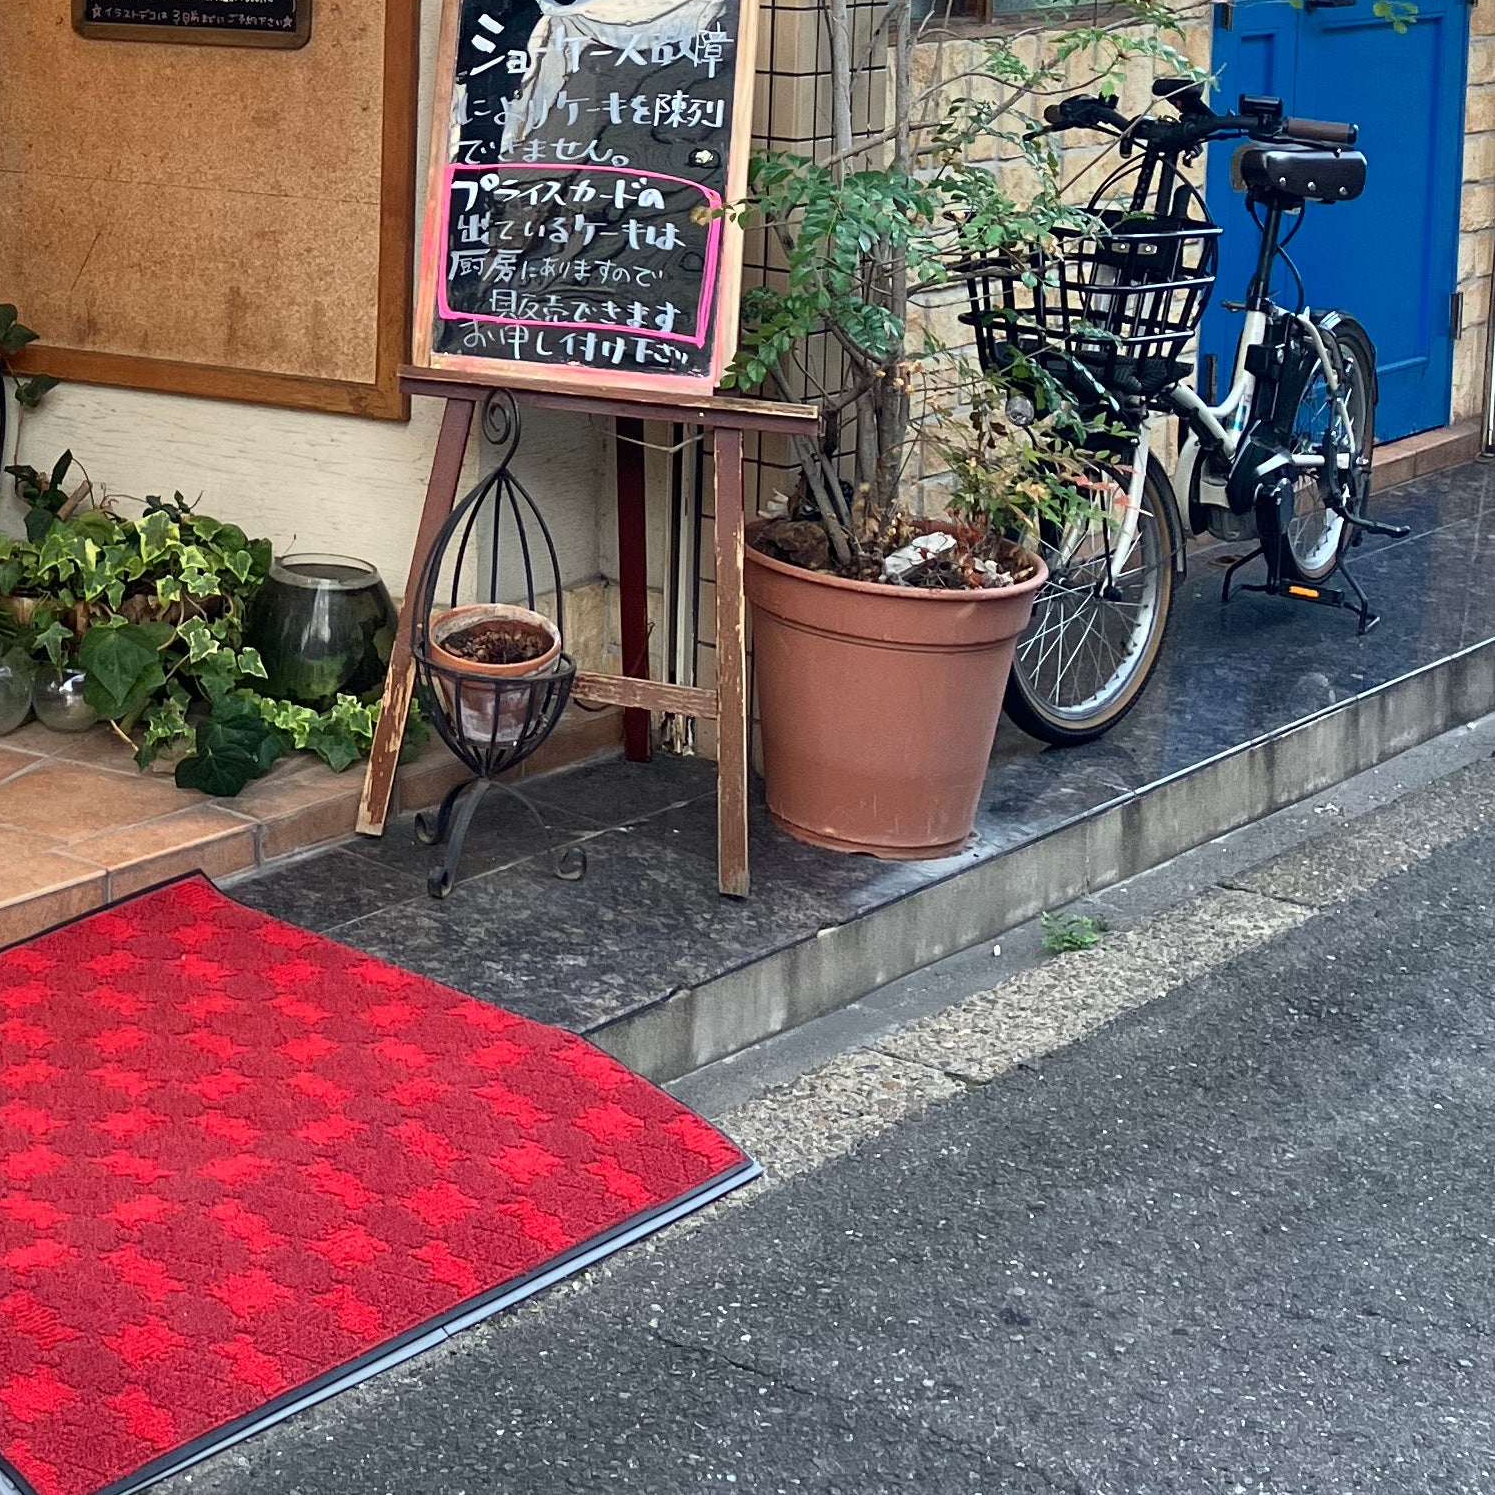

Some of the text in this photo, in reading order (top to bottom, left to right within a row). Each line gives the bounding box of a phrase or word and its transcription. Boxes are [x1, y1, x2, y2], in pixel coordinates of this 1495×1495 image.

[470, 13, 734, 79] ショーケース故障
[459, 90, 725, 128] によりケーキを陳列
[458, 137, 630, 168] できません。
[451, 173, 666, 212] プライスカードの
[458, 212, 686, 251] 出ているケーキは
[448, 248, 664, 288] 厨房にありますので
[489, 289, 681, 333] 販売できます
